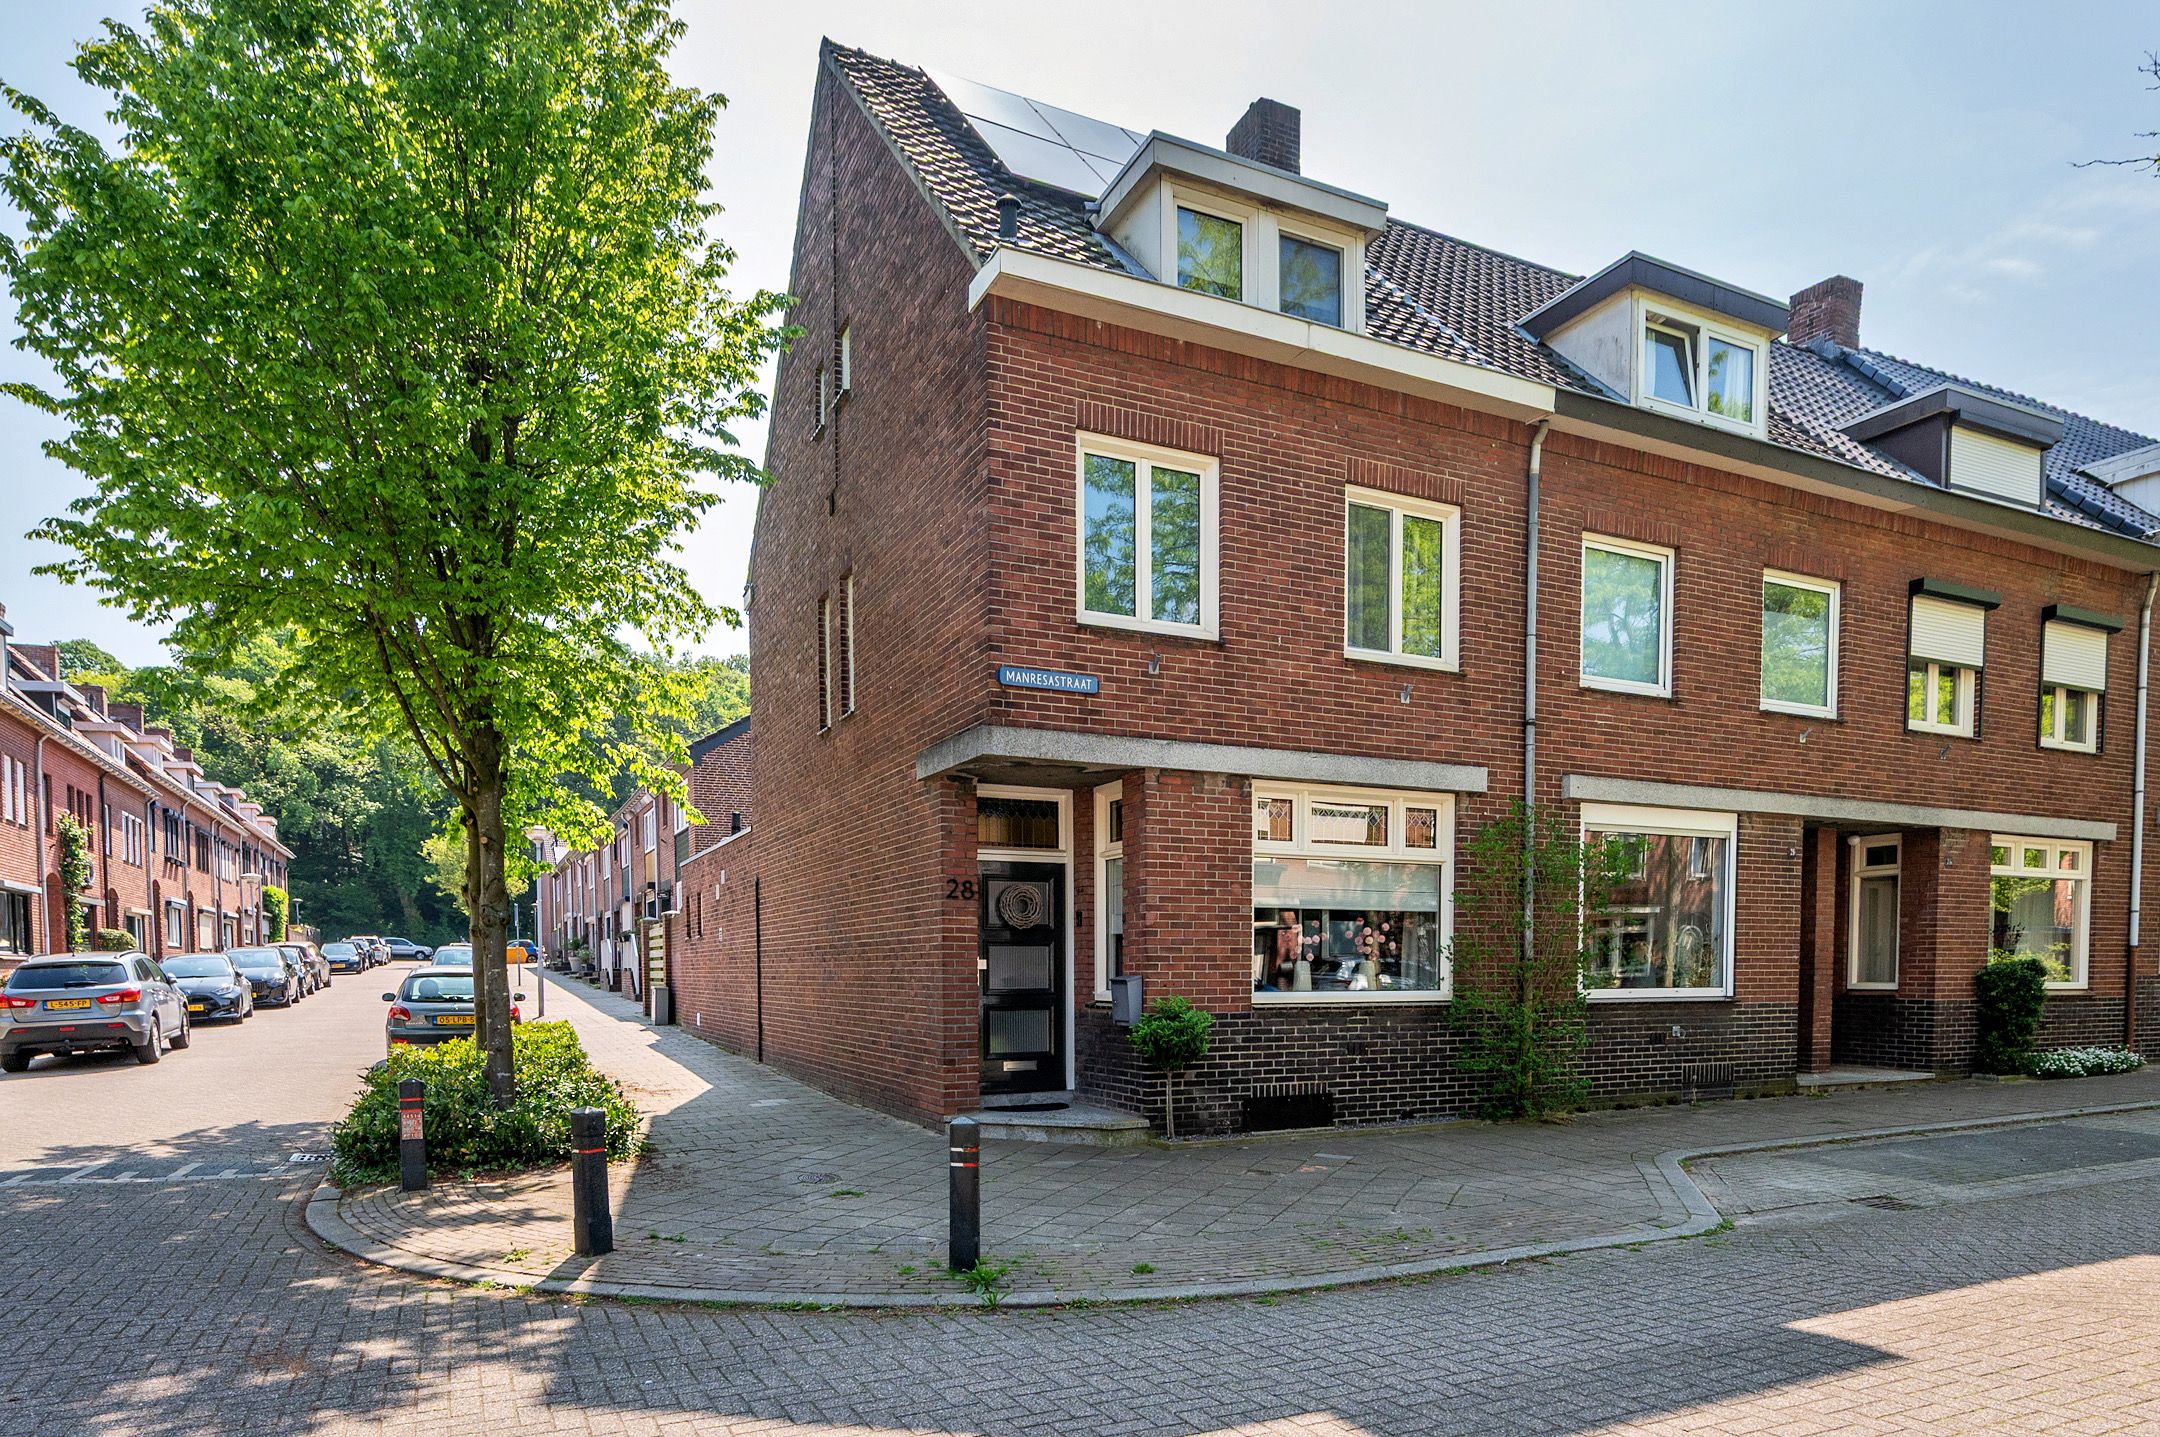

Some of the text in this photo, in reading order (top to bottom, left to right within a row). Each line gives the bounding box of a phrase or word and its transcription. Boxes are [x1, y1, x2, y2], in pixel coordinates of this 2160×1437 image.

[1006, 670, 1092, 690] MANRESASTRAAT
[946, 879, 974, 899] 28
[50, 1000, 87, 1008] L-545-FP
